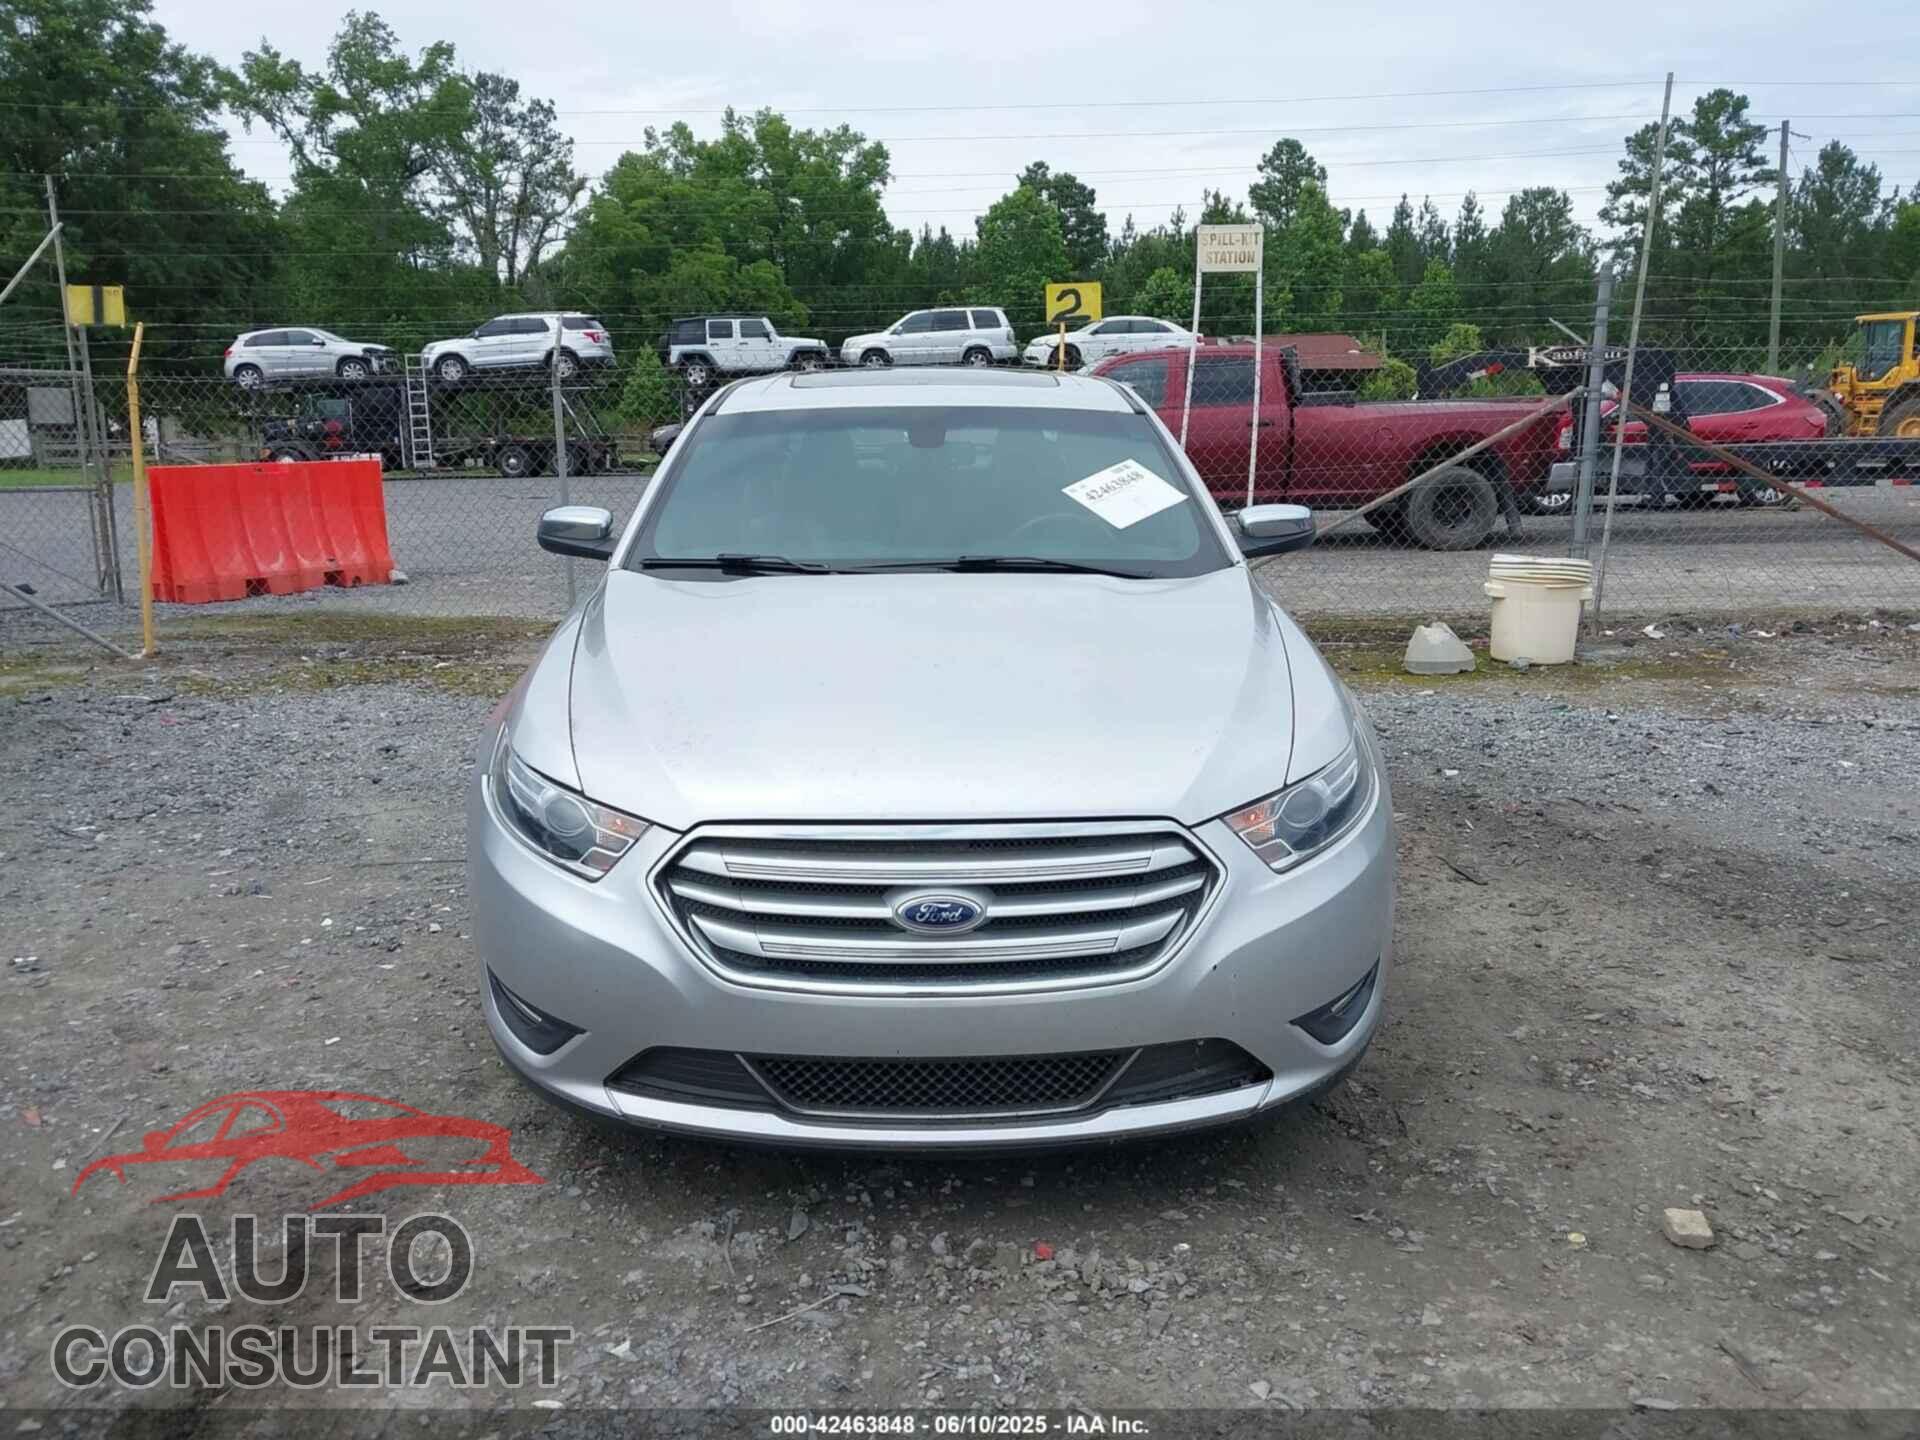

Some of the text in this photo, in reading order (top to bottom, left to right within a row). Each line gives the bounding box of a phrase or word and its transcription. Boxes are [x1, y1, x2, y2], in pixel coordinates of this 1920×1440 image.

[1207, 250, 1255, 264] STATION
[1052, 288, 1091, 325] 2
[915, 902, 964, 922] Ford
